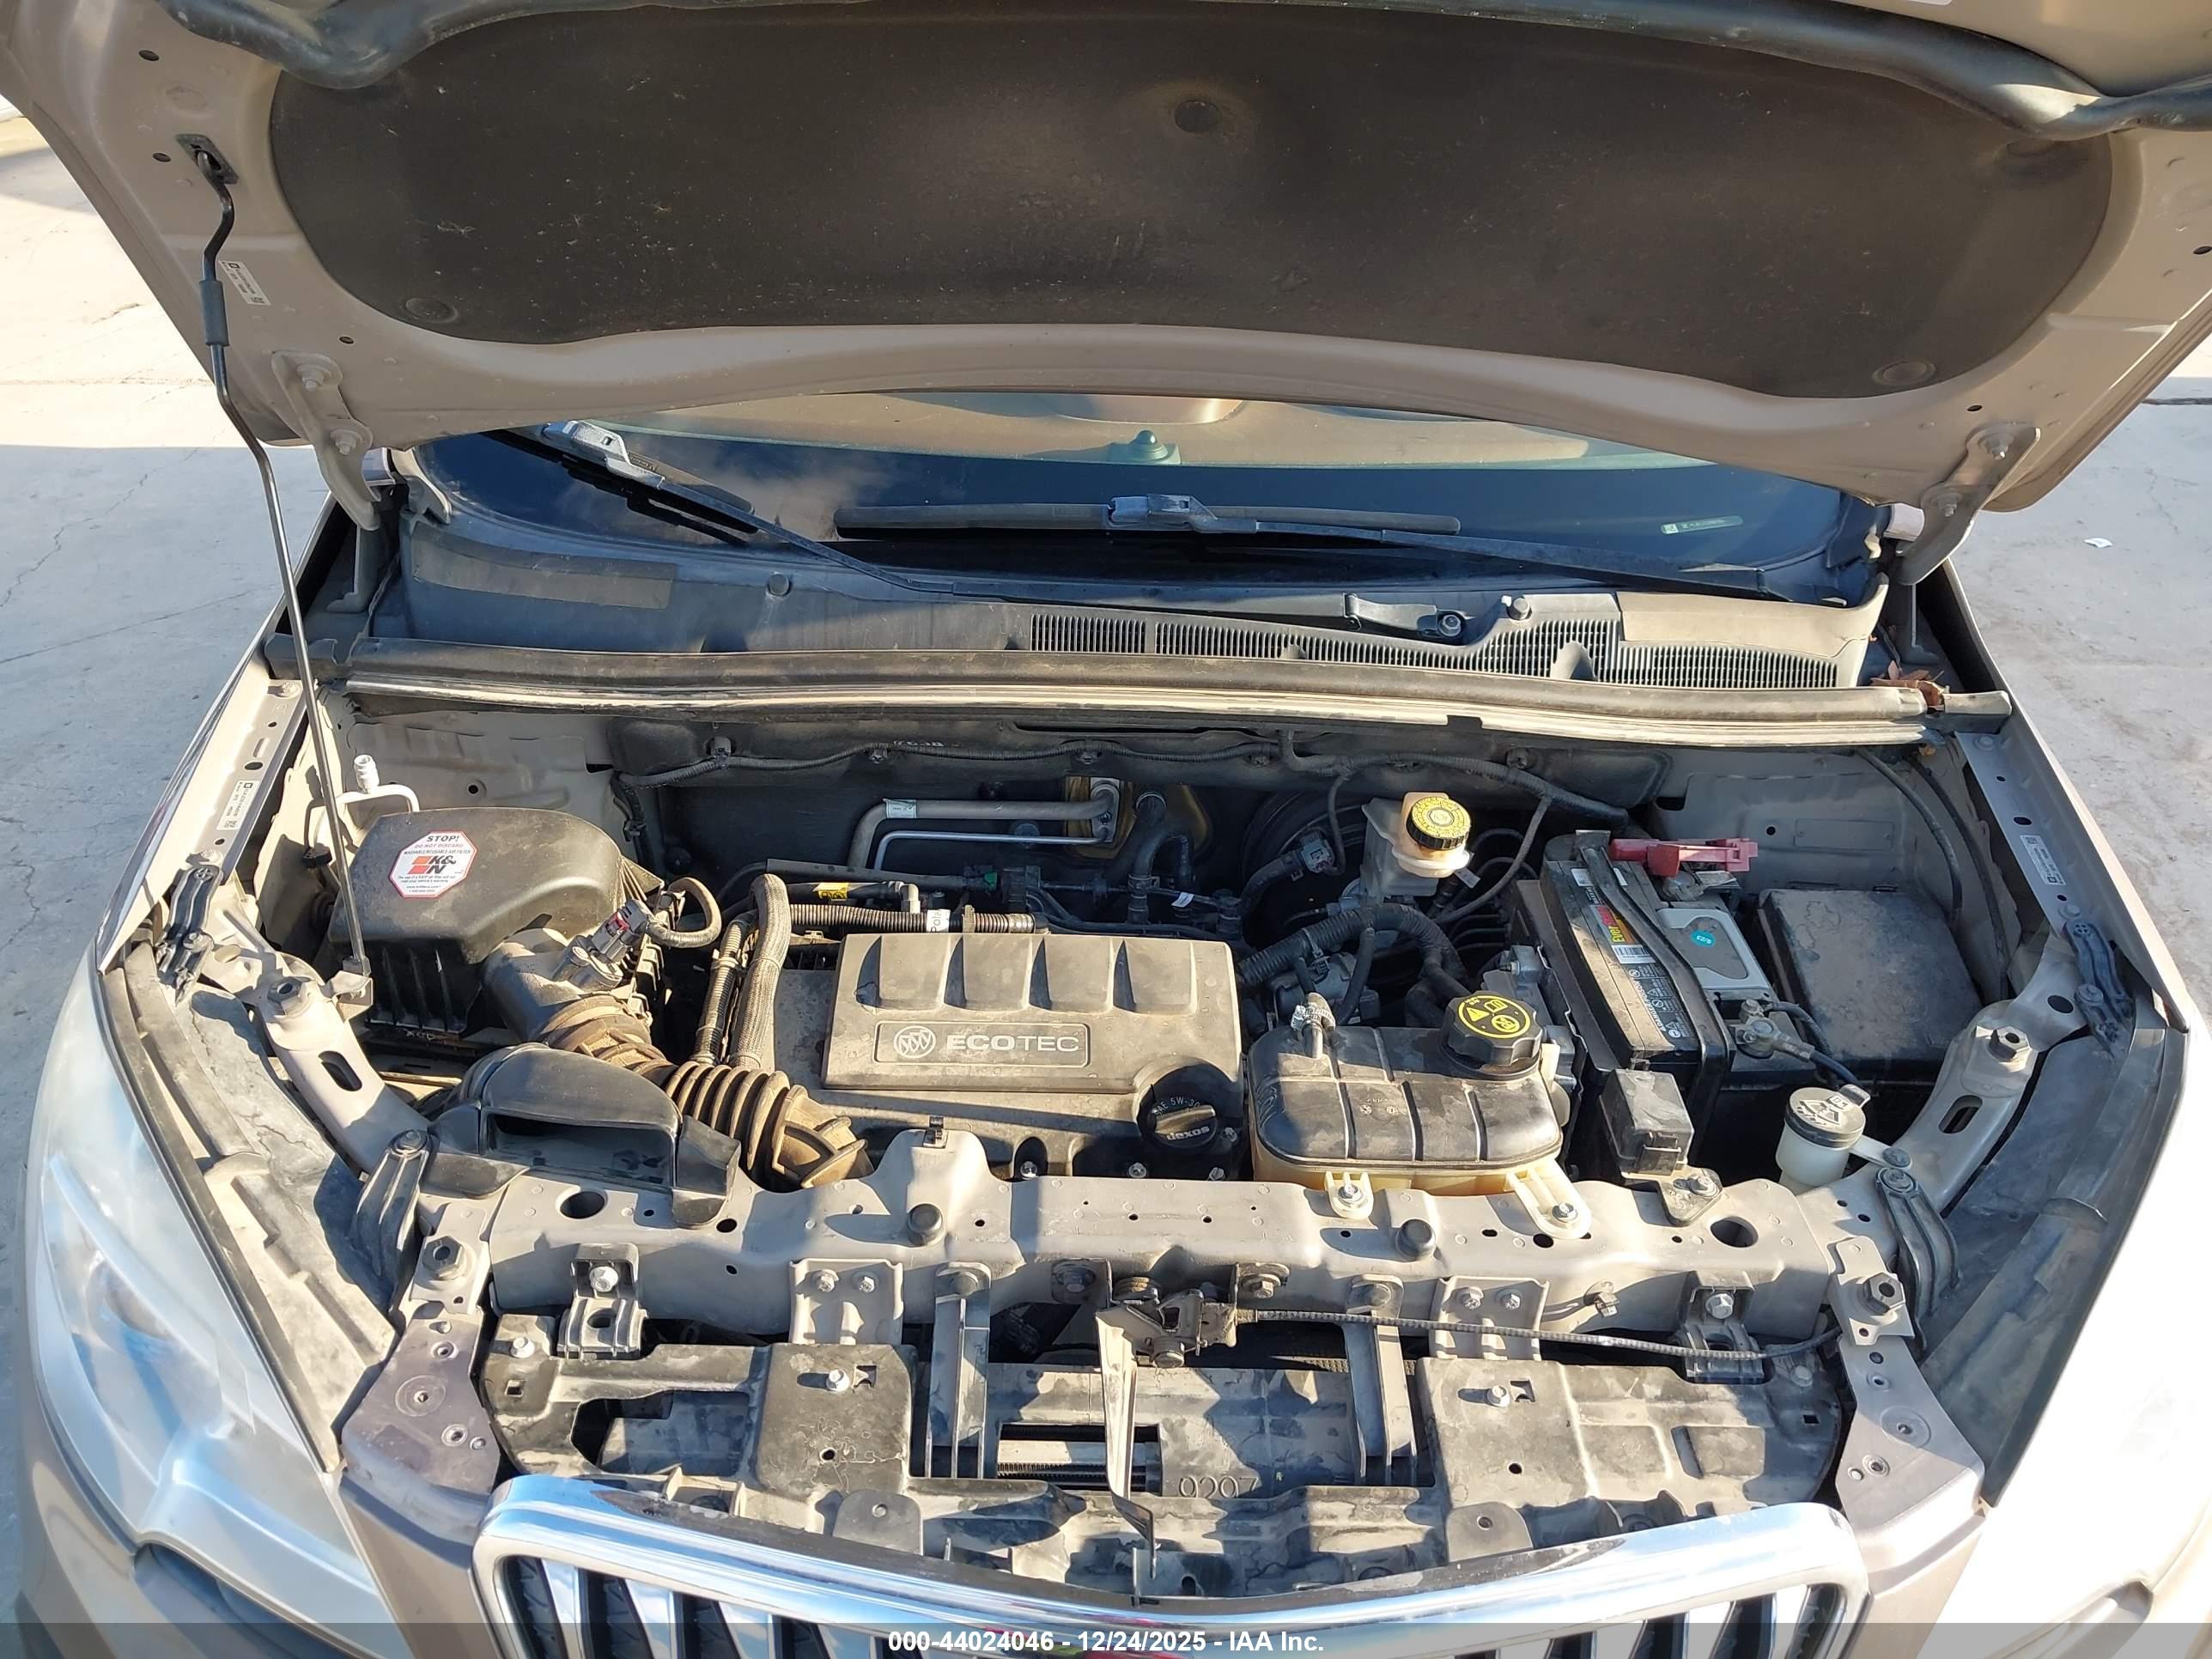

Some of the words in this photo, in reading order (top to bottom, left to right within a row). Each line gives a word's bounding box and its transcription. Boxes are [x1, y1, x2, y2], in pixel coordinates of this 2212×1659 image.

[945, 1035, 1080, 1052] ECOTEC
[1170, 1096, 1200, 1108] 5W-30
[1166, 1126, 1210, 1140] dexos
